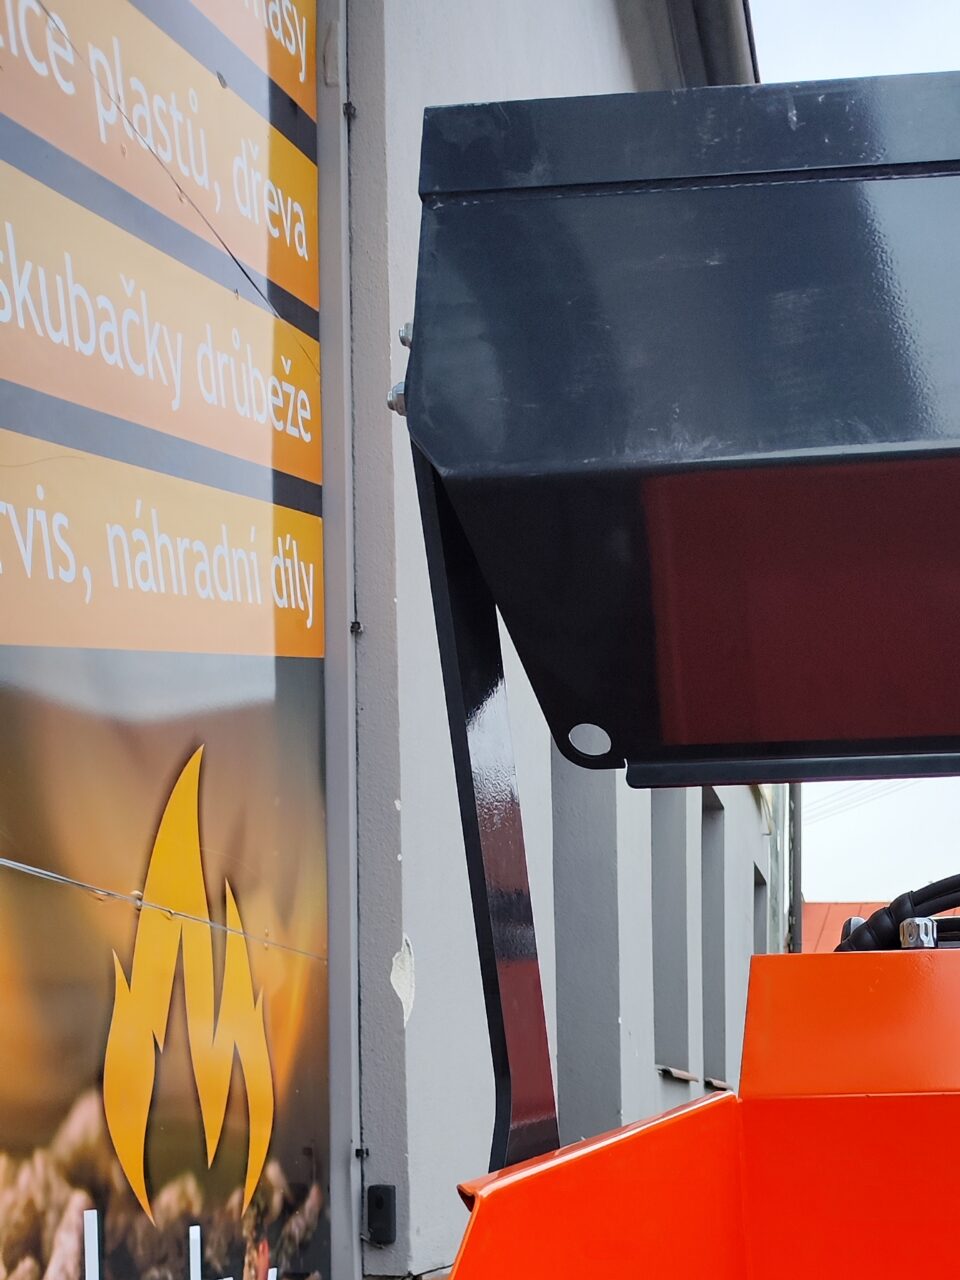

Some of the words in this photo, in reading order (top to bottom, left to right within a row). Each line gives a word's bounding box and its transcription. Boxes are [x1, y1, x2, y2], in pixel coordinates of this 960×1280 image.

[242, 0, 306, 83] asy
[88, 35, 222, 214] plastů,
[232, 137, 309, 262] dřeva
[196, 323, 312, 442] drůbeže
[0, 484, 92, 605] vis,
[105, 498, 262, 605] náhradní
[270, 534, 314, 629] díly
